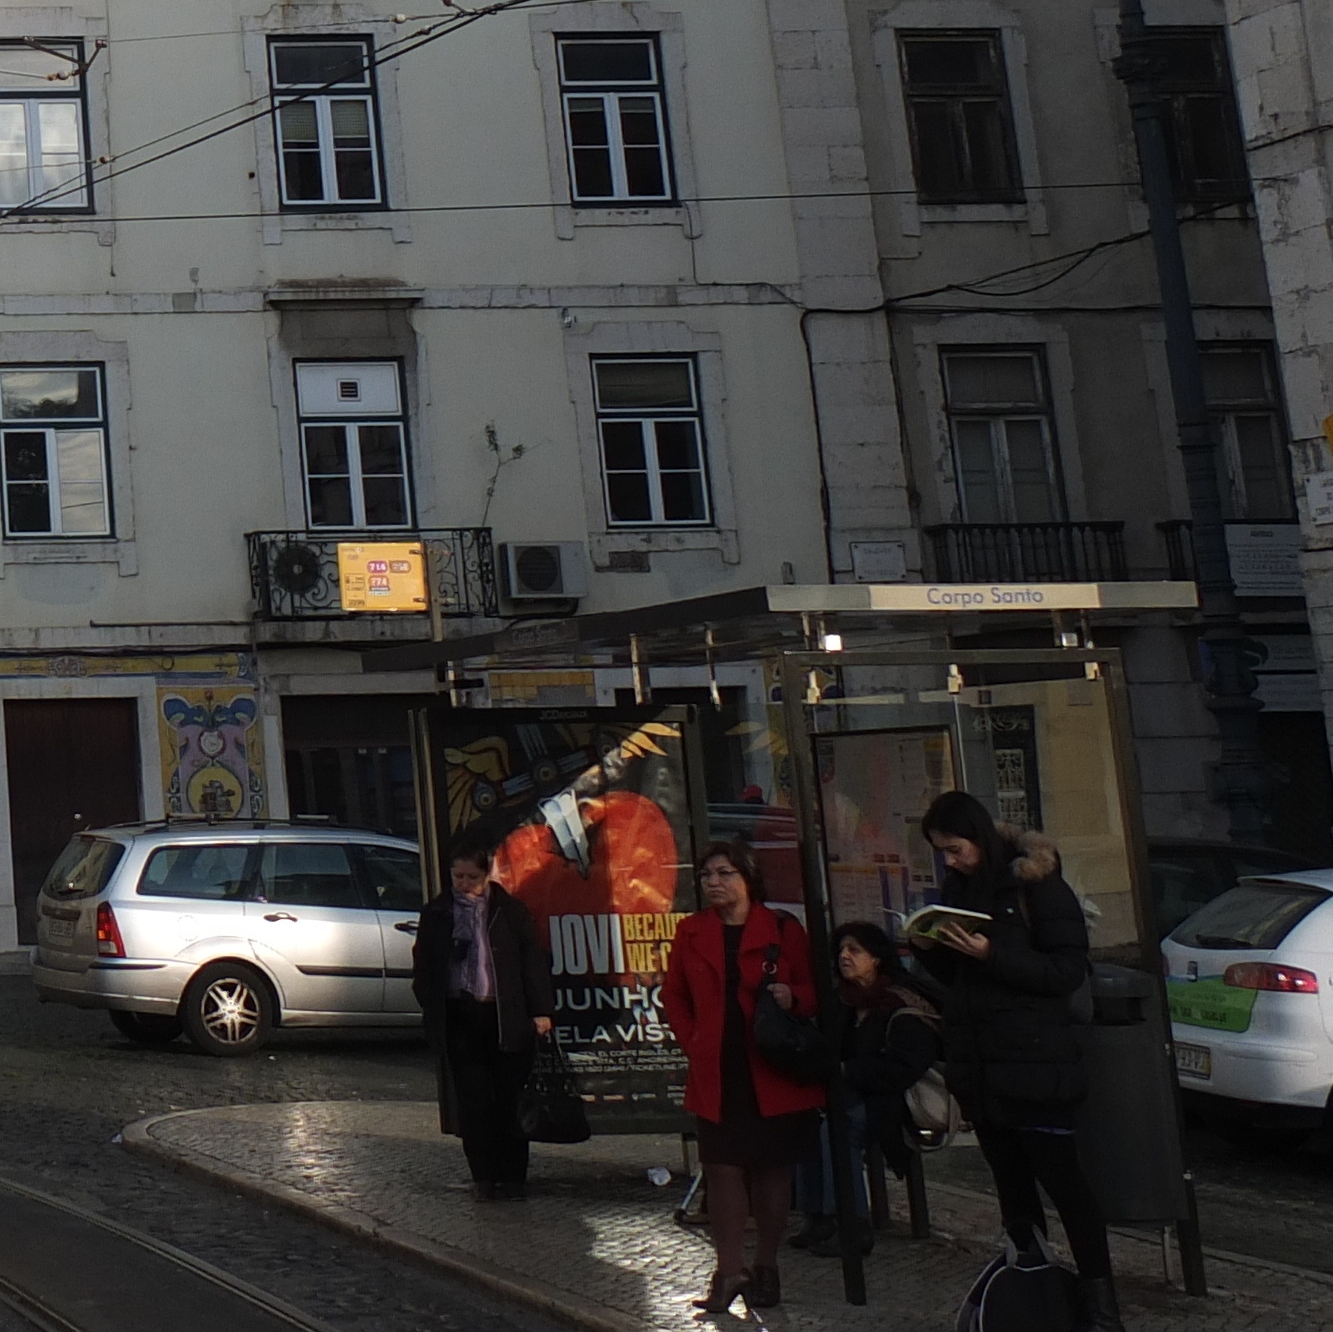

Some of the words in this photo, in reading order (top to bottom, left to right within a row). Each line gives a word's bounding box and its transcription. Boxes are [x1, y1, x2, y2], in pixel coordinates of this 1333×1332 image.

[927, 588, 984, 607] Corpo
[991, 587, 1043, 604] Santo
[623, 912, 694, 940] BECAU
[549, 913, 625, 975] JOVI
[626, 942, 657, 973] WE
[545, 1025, 612, 1044] ELA
